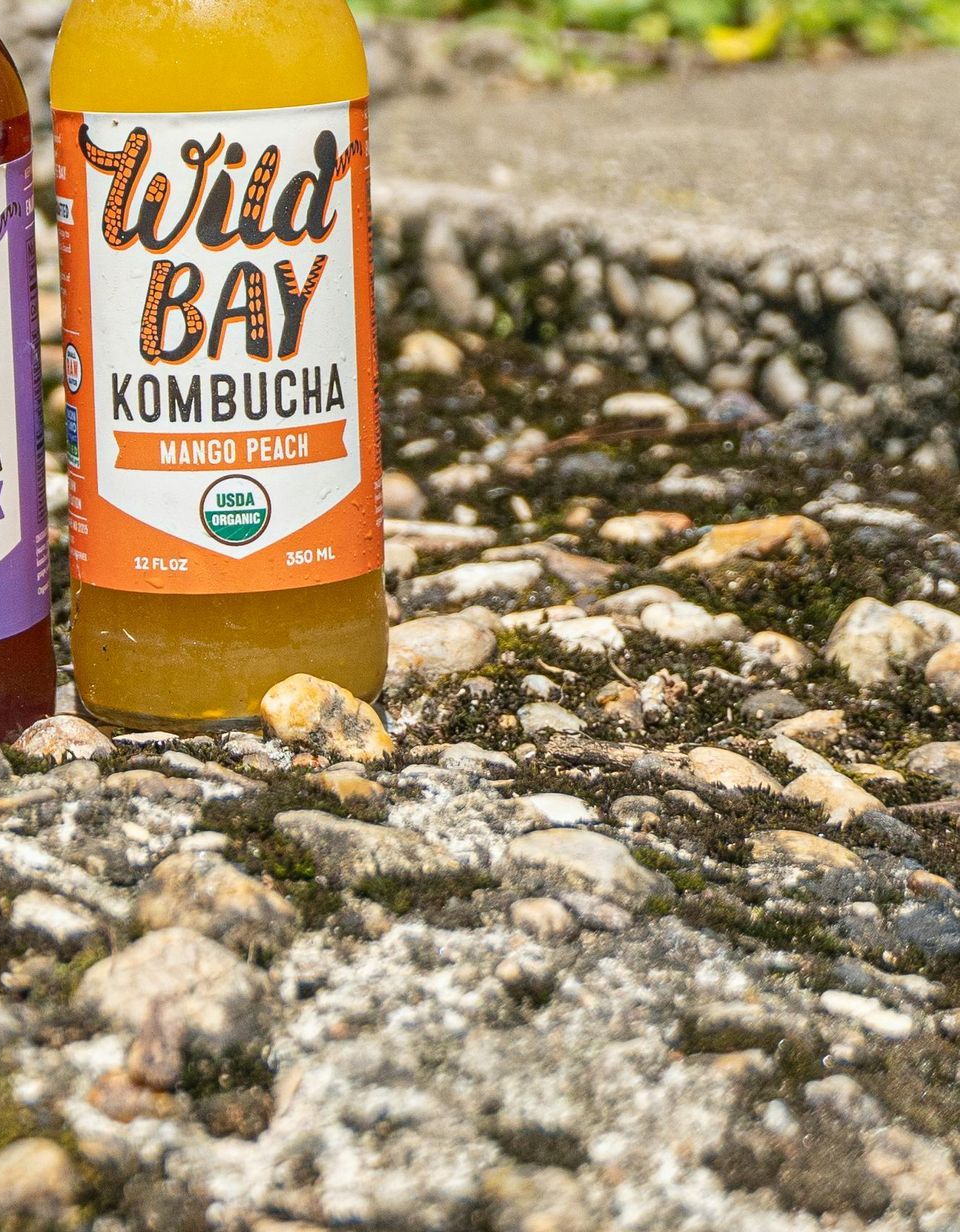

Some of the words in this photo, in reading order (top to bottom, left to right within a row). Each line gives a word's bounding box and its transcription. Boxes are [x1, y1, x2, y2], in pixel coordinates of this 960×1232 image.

[78, 123, 363, 255] Wild
[139, 254, 329, 365] BAY
[112, 363, 345, 423] KOMBUCHA
[160, 438, 236, 465] MANGO
[246, 432, 309, 462] PEACH
[216, 492, 255, 508] USDA
[211, 512, 261, 526] ORGANIC
[134, 556, 149, 570] 12
[286, 551, 313, 566] 350
[316, 547, 335, 562] ML
